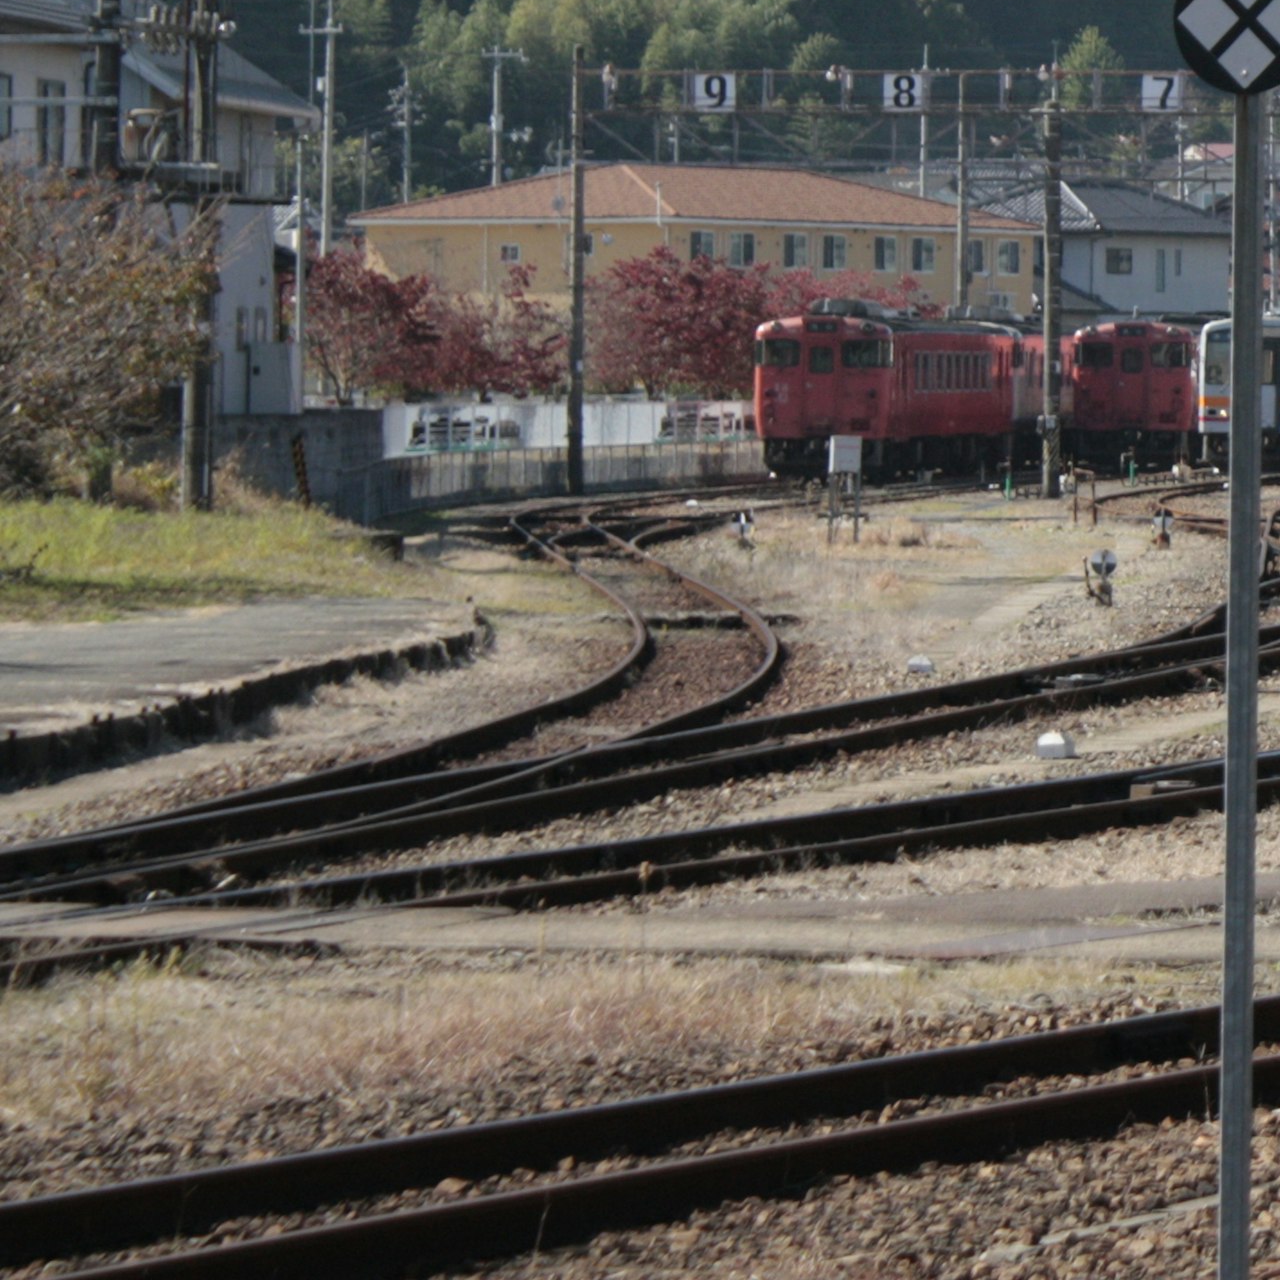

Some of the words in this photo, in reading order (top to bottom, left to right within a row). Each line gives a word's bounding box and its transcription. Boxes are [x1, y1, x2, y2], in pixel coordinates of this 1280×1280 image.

[704, 75, 727, 109] 9
[892, 75, 918, 109] 8
[1150, 76, 1175, 110] 7
